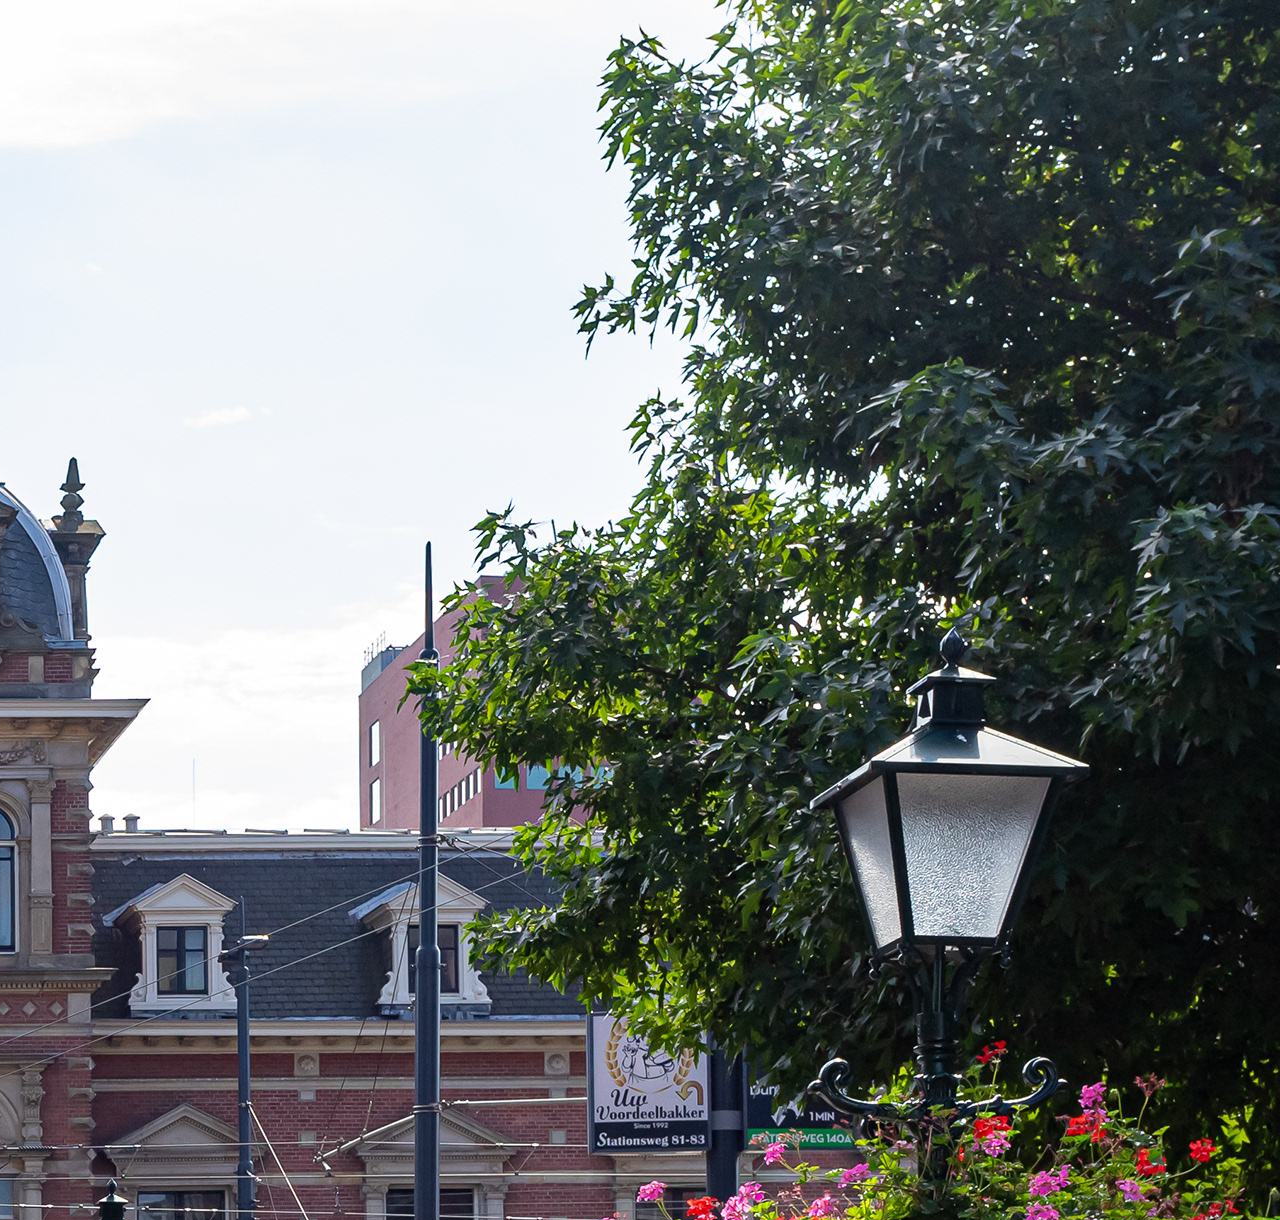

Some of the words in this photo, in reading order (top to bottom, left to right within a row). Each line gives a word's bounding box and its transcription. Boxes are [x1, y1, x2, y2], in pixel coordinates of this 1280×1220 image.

[611, 1088, 648, 1108] Uw
[596, 1104, 705, 1120] Voordeelbakker
[815, 1112, 835, 1121] MIN
[596, 1132, 669, 1147] Stationsweg
[671, 1134, 705, 1145] 81-83
[826, 1133, 852, 1144] 140A
